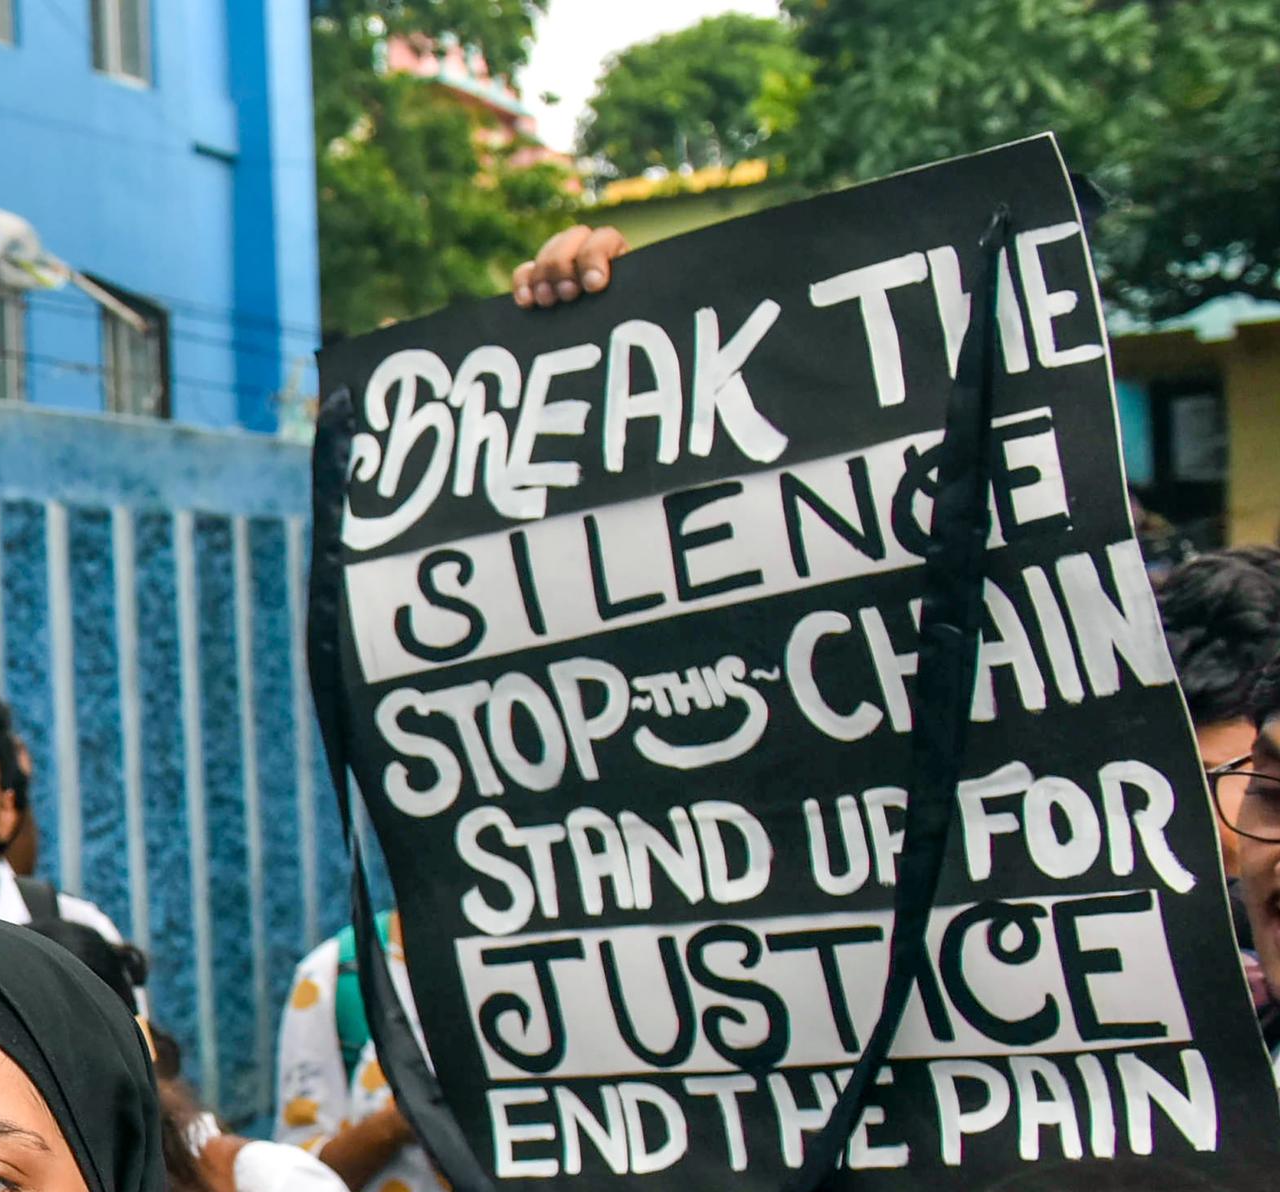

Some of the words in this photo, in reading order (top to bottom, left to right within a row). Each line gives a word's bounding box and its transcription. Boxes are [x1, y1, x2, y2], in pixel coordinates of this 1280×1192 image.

[340, 299, 788, 550] BREAK
[809, 220, 1106, 408] THE
[373, 657, 630, 818] STOP
[786, 539, 1174, 742] CHAIN
[457, 800, 771, 935] STAND
[804, 786, 908, 896] UP
[957, 760, 1195, 894] FOR
[478, 889, 1167, 1075] JUSTICE
[487, 1075, 688, 1178] END
[680, 1064, 910, 1171] THE
[929, 1049, 1217, 1166] PAIN
